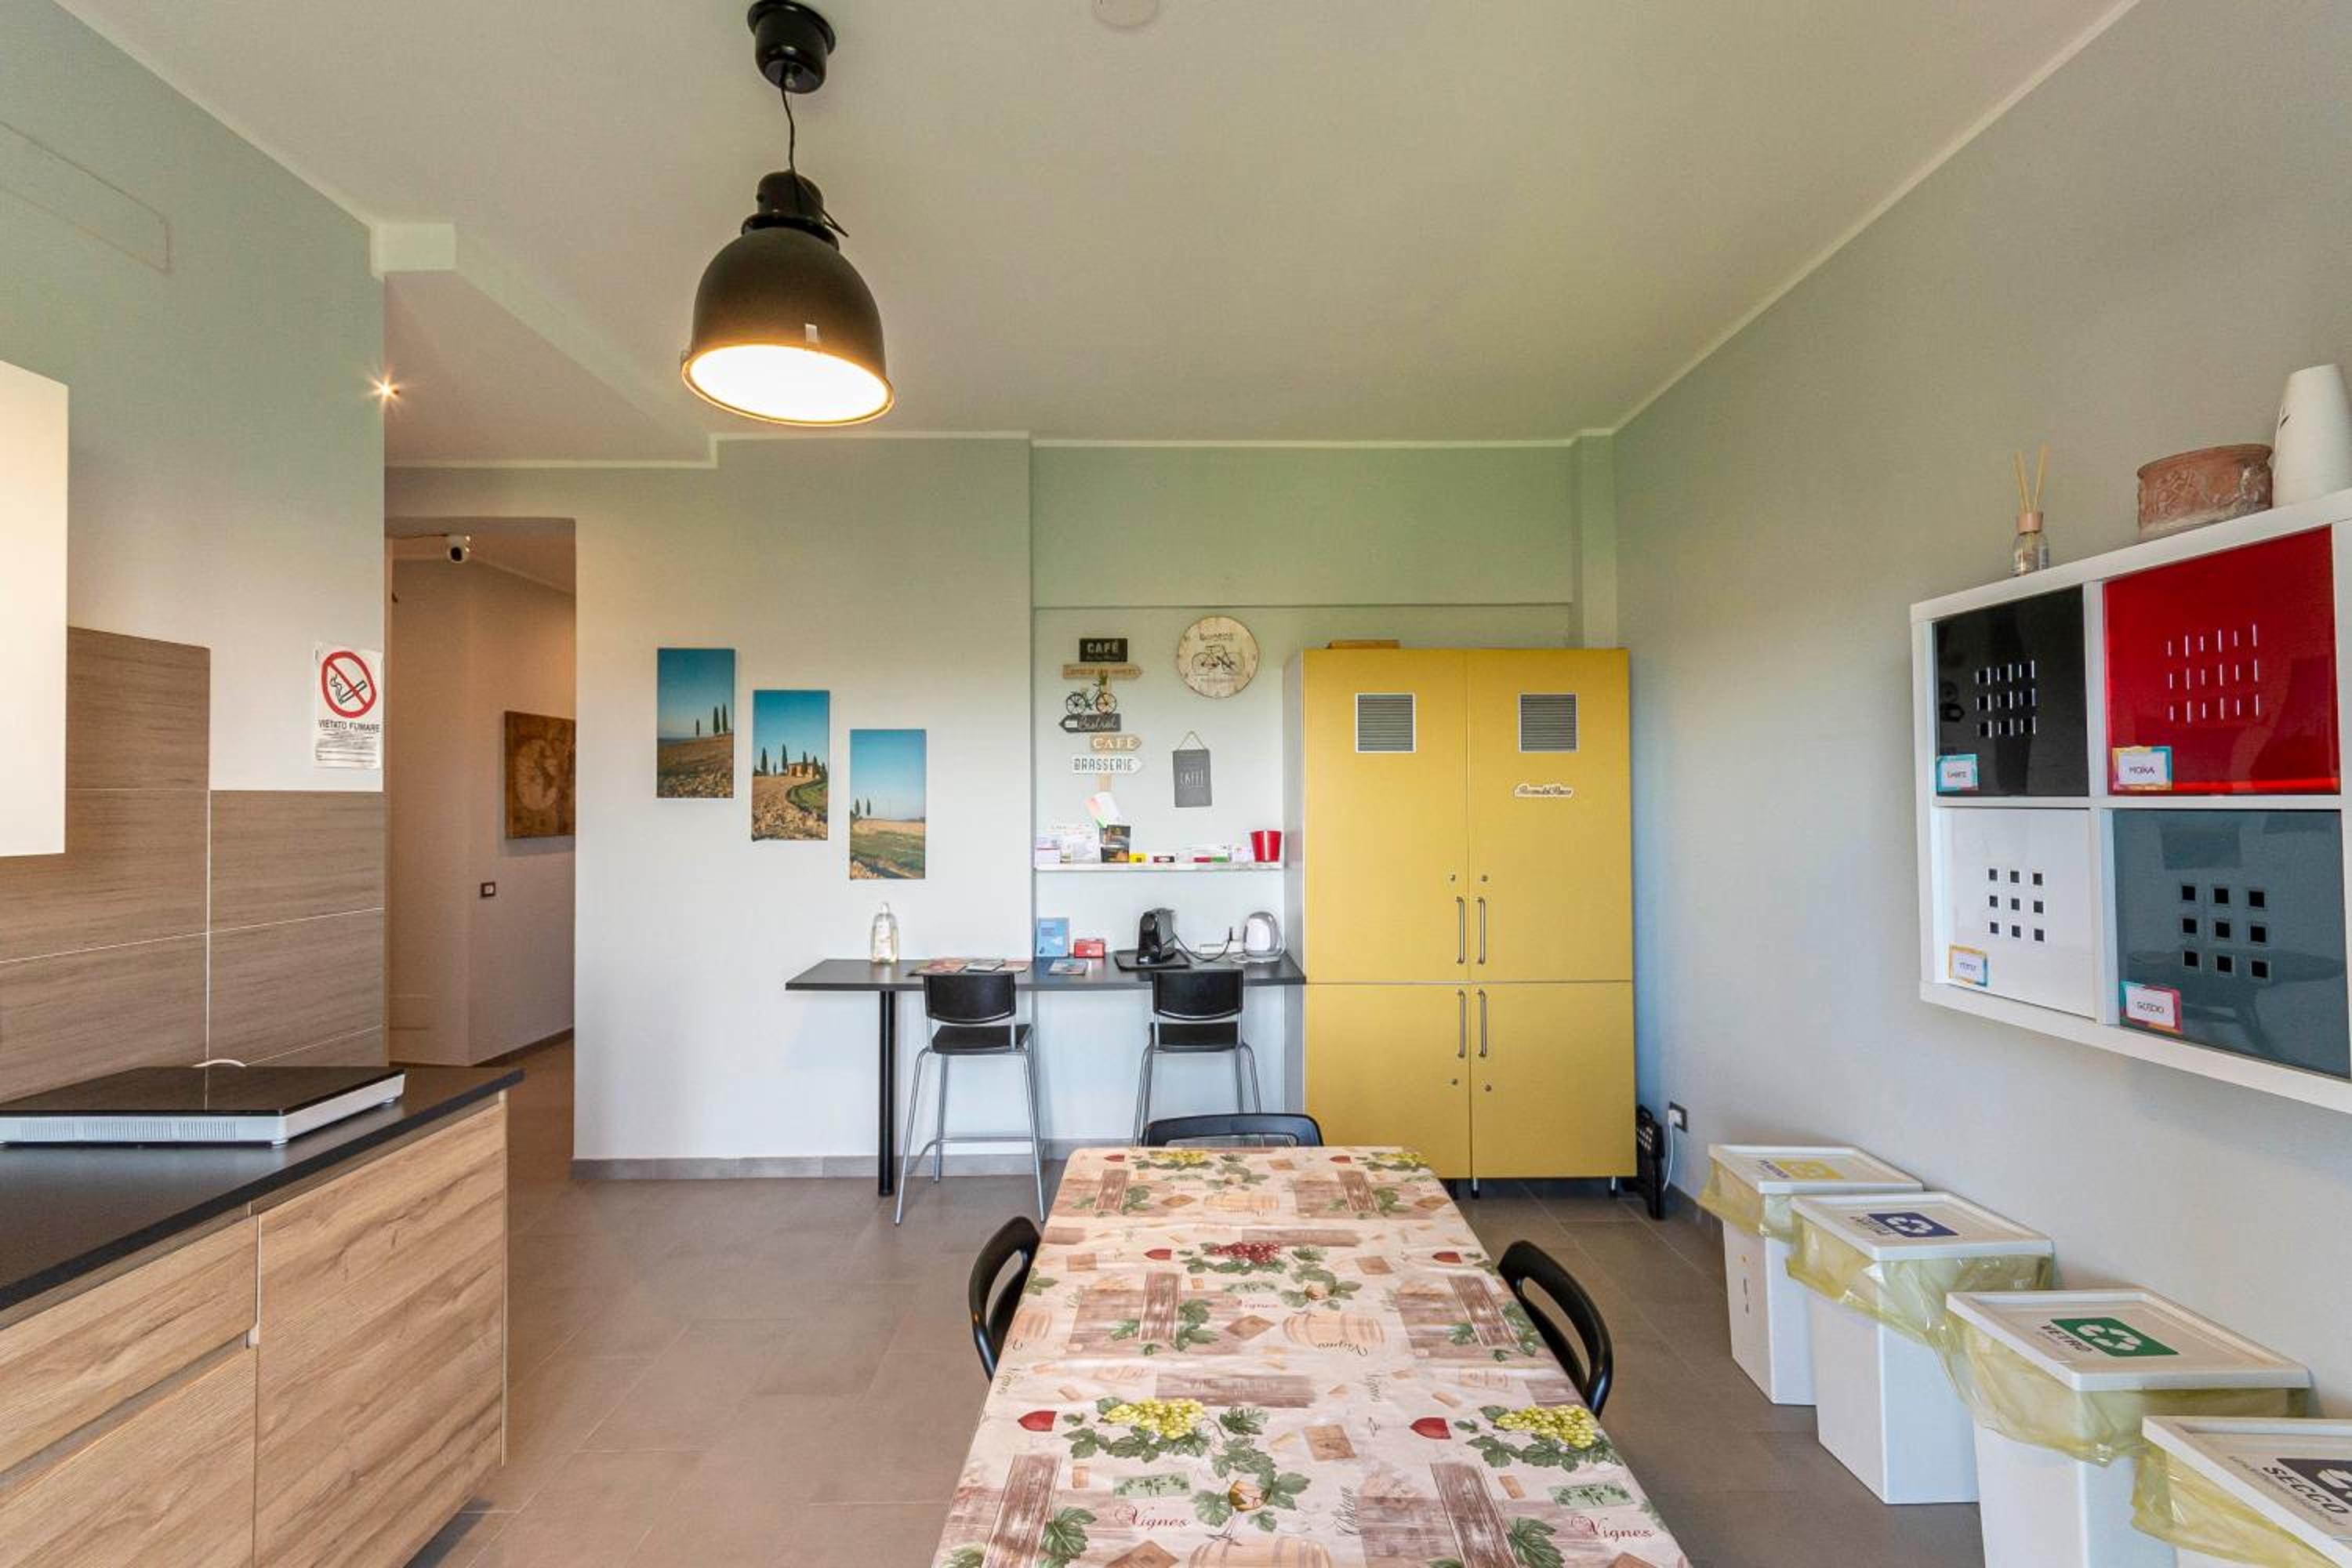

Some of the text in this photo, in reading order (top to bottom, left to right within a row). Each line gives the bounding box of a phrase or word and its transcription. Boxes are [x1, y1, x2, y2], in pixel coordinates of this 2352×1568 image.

[318, 719, 380, 733] VIETATO FUMARE
[1073, 758, 1134, 771] BRASSERIE
[2262, 1467, 2349, 1514] SECCO
[1114, 1504, 1190, 1531] Vignes
[1570, 1515, 1655, 1543] Vignes
